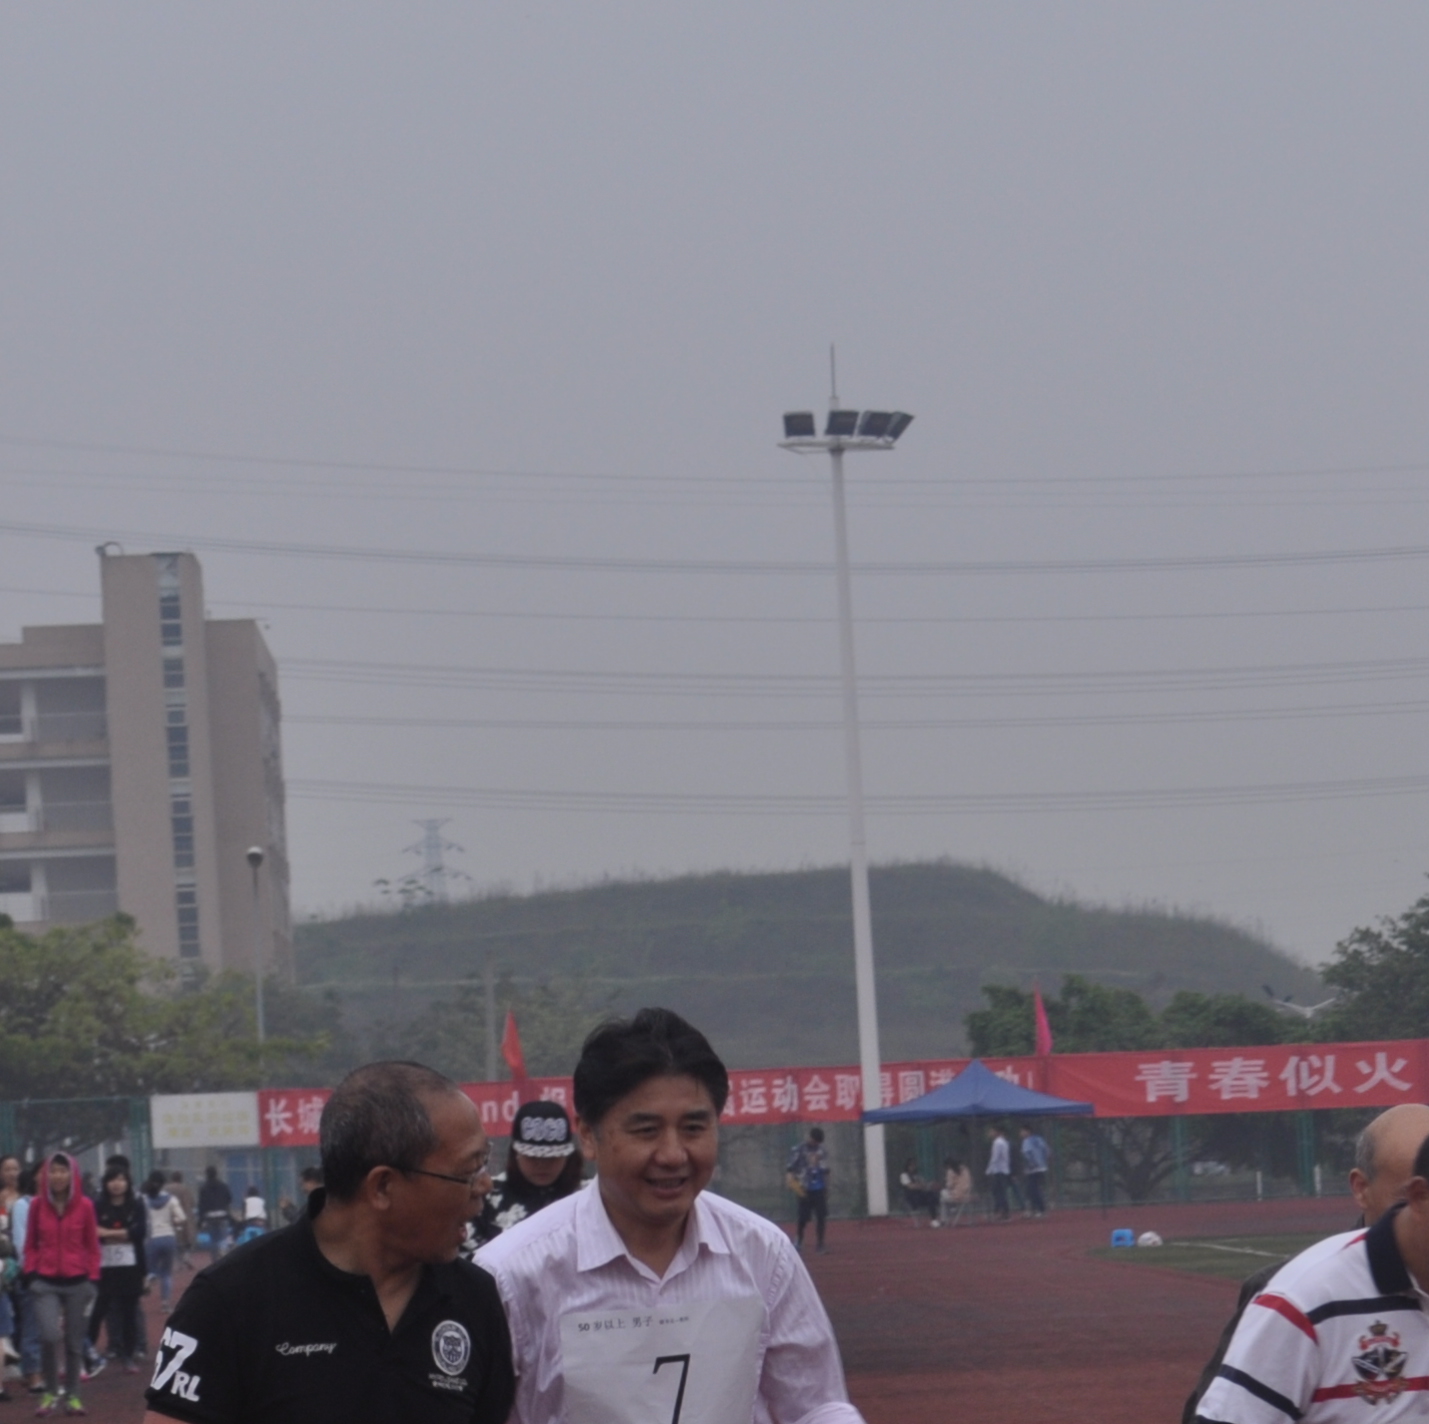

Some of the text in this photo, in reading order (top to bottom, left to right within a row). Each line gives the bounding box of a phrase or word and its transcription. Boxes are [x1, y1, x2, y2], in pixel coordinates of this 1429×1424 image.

[1135, 1052, 1413, 1103] 青春似火
[275, 1342, 338, 1357] Company
[171, 1371, 201, 1402] RL
